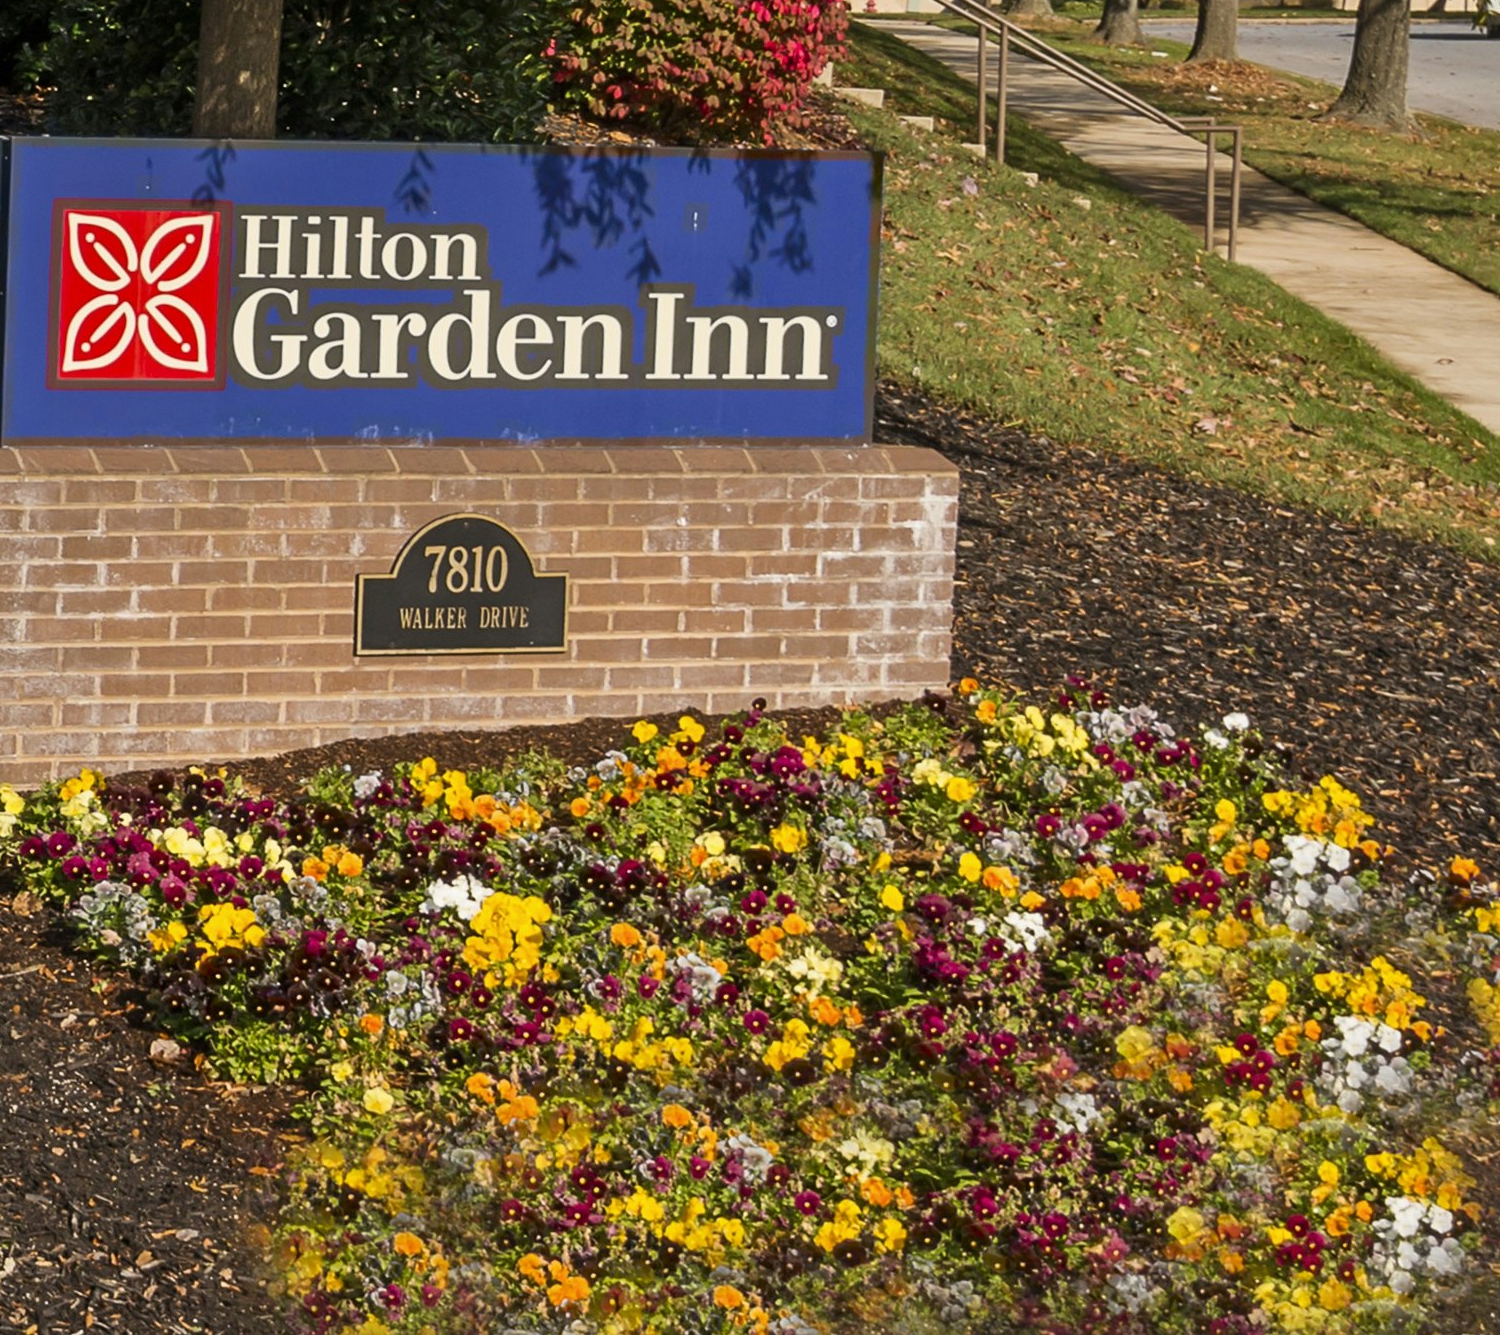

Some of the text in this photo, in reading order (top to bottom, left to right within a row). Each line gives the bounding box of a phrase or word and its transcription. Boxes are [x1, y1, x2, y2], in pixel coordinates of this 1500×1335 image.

[238, 214, 482, 281] Hilton
[232, 287, 629, 381] Garden
[424, 545, 508, 594] 7810
[399, 605, 530, 630] WALKER DRIVE
